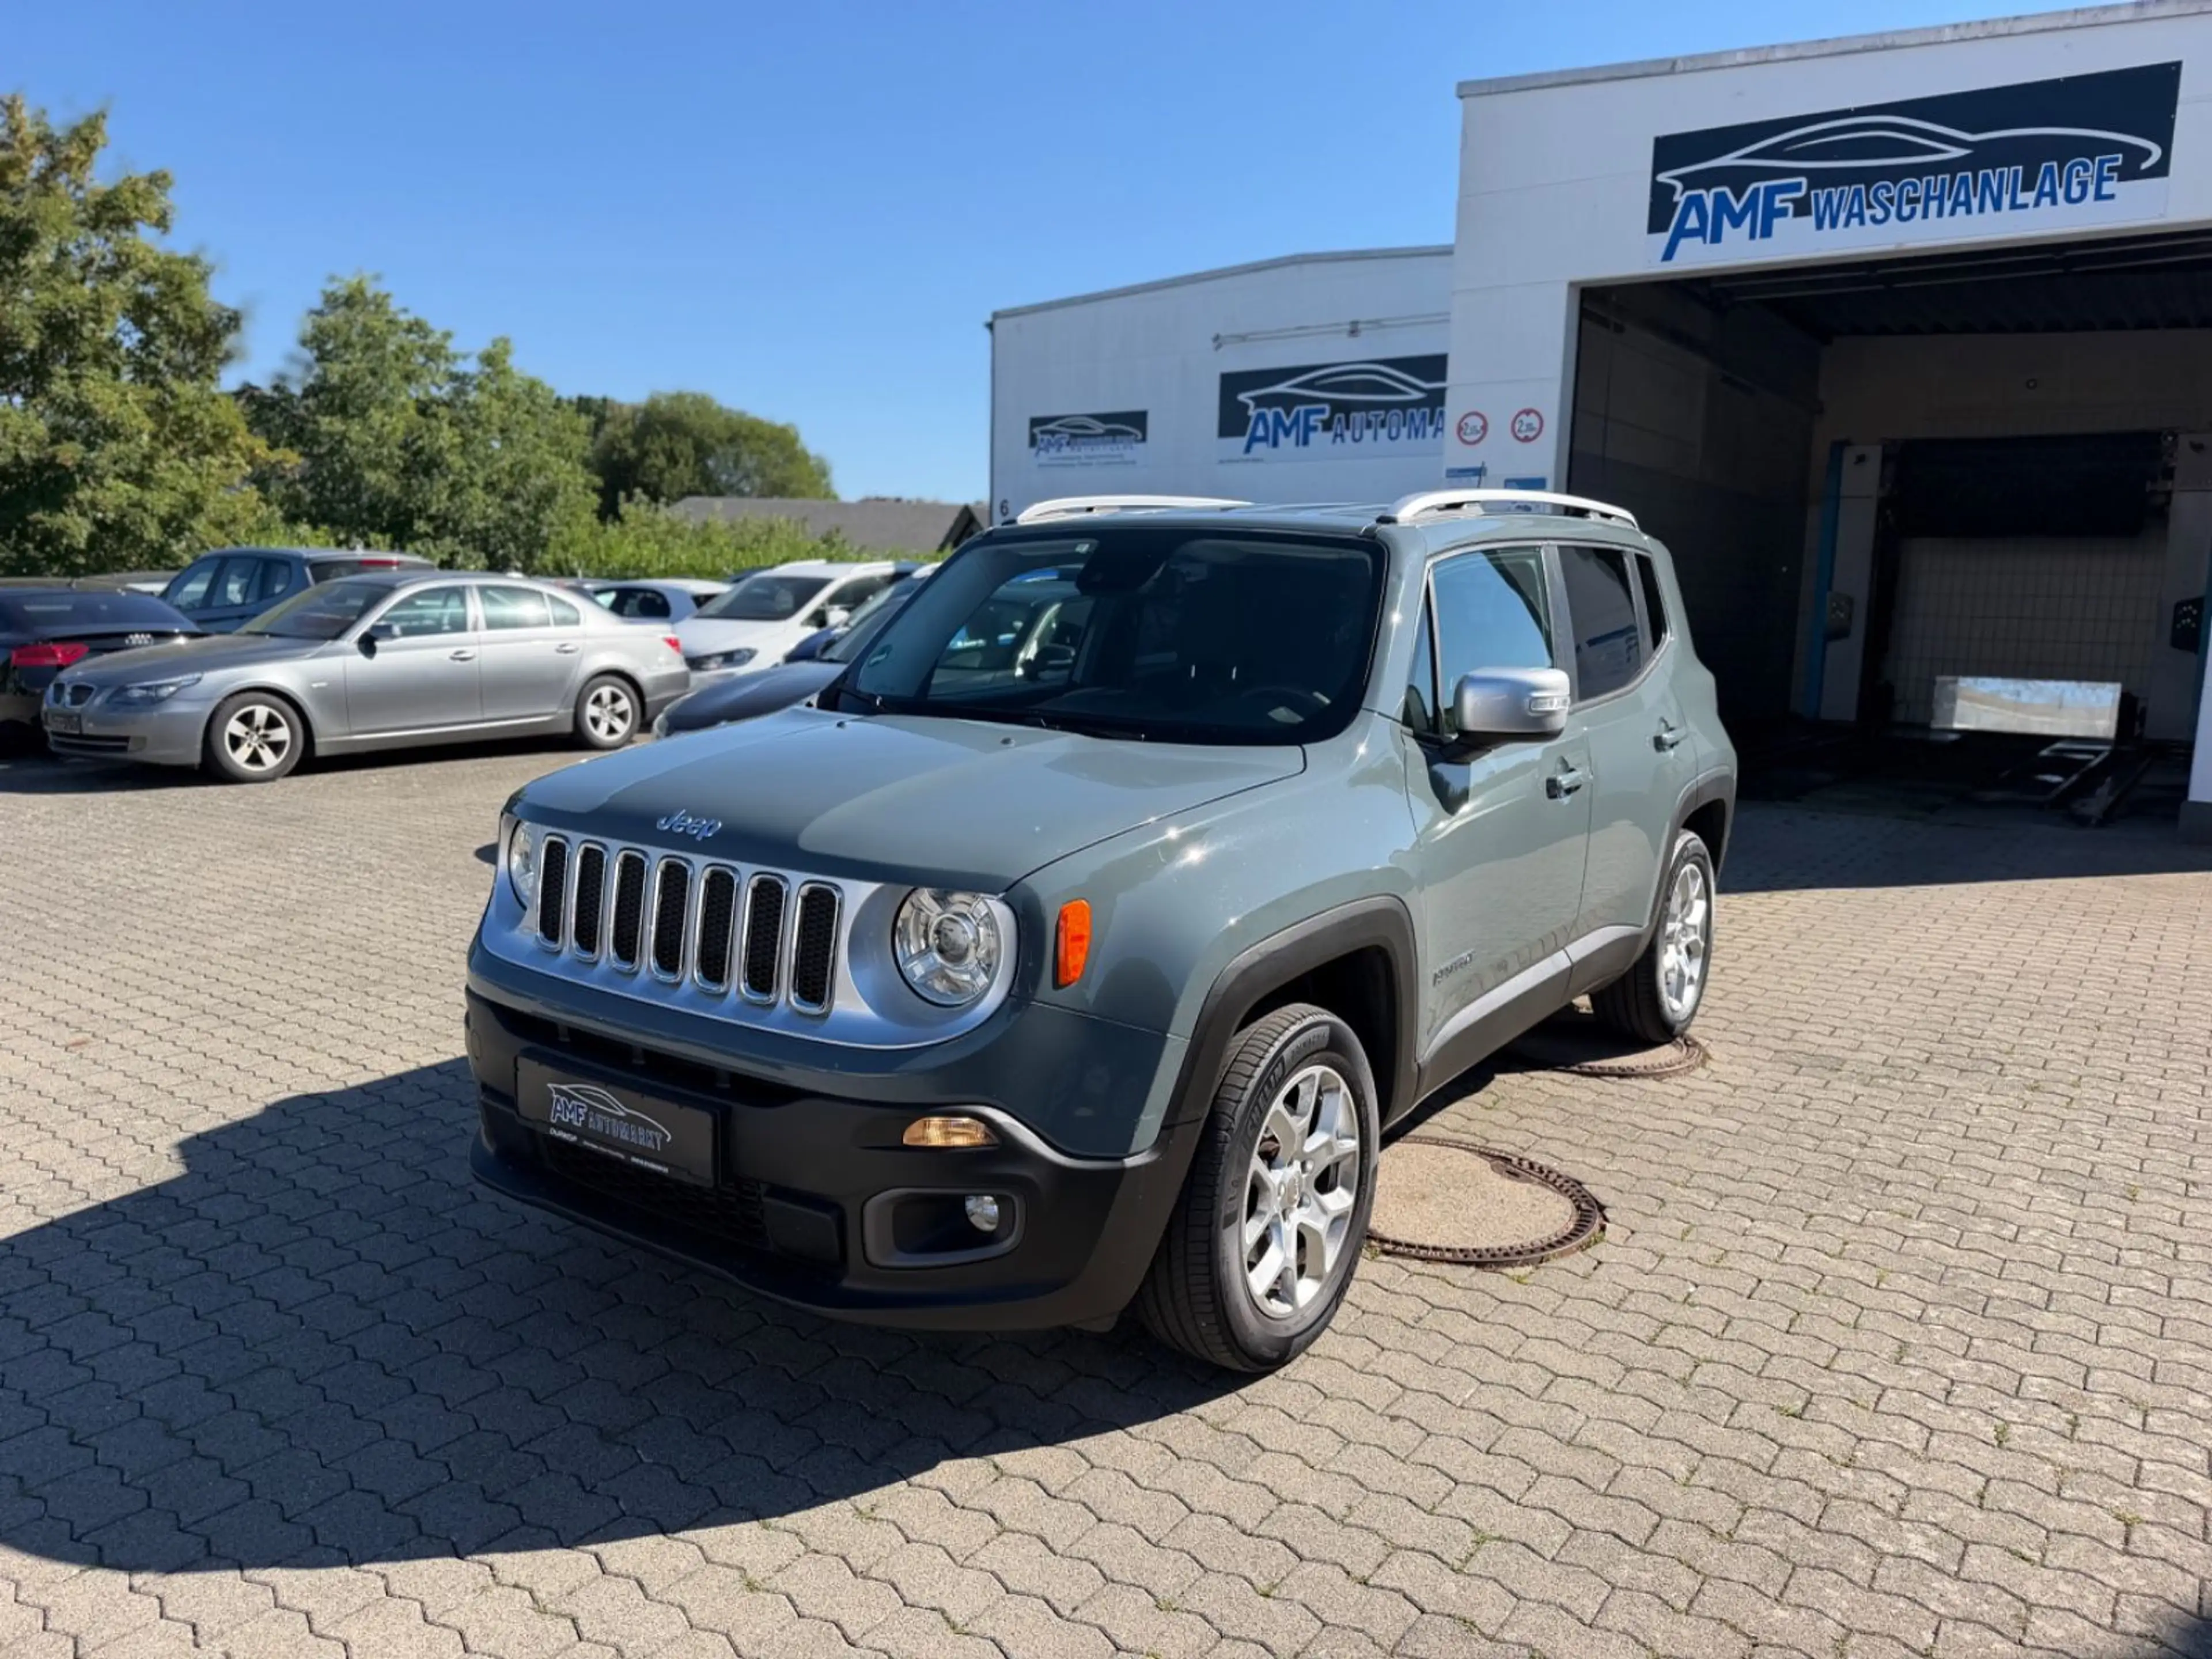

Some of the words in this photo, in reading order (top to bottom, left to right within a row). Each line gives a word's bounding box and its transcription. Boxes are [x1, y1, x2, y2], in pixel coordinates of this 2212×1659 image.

[1661, 176, 1806, 263] AMF
[1810, 154, 2123, 231] WASCHANLAGE
[1243, 404, 1330, 454] AMF
[999, 498, 1010, 517] 6
[656, 808, 723, 842] Jeep
[550, 1094, 588, 1127] AMF
